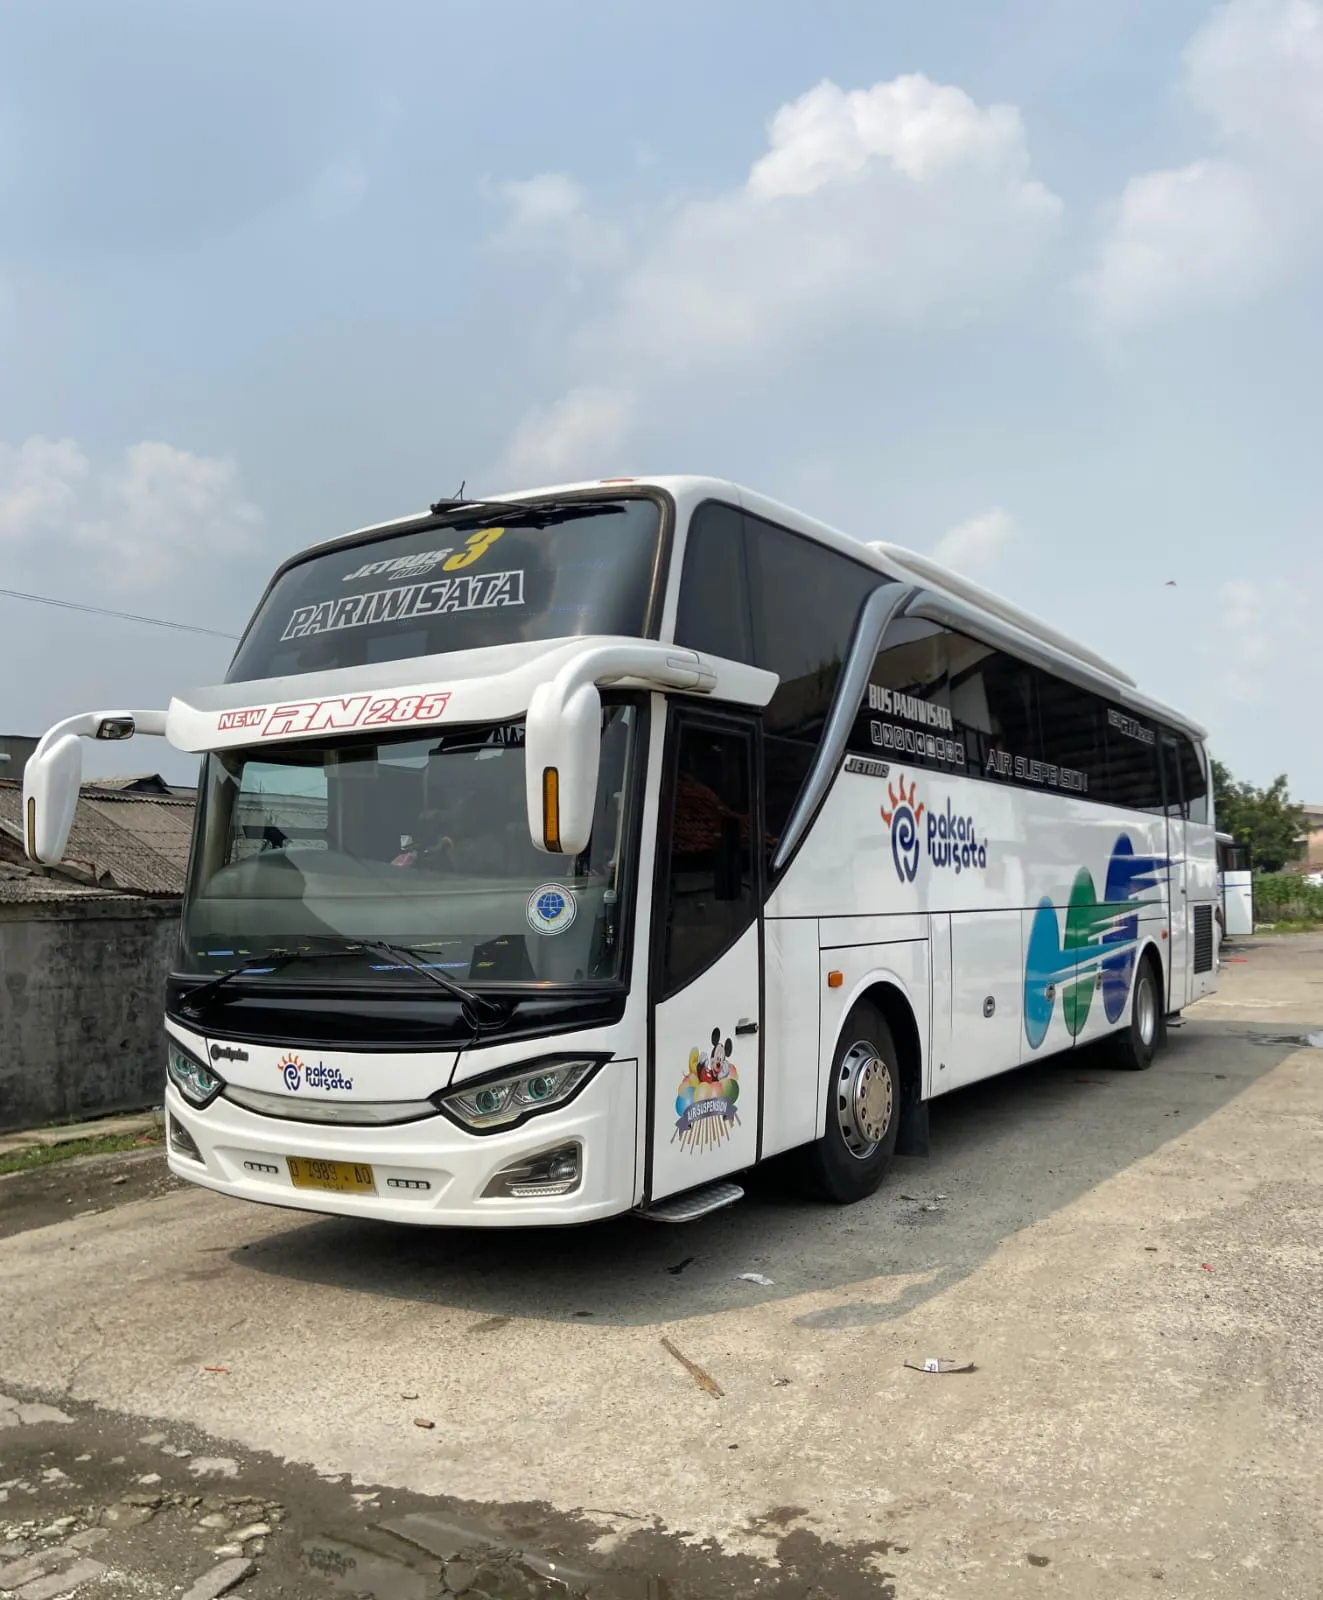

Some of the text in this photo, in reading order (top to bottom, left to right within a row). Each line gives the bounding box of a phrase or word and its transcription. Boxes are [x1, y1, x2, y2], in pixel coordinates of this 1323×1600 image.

[342, 548, 454, 582] JETBUS
[442, 527, 505, 571] 3
[280, 570, 525, 642] PARIWISATA
[218, 692, 452, 737] NEW RN 285
[869, 683, 953, 732] BUS PARIWISATA
[846, 758, 889, 779] JETBUS
[985, 748, 1013, 776] AIR
[927, 796, 973, 856] pakar
[932, 827, 987, 875] wisata
[305, 1060, 340, 1082] pakar
[308, 1073, 352, 1091] wisata
